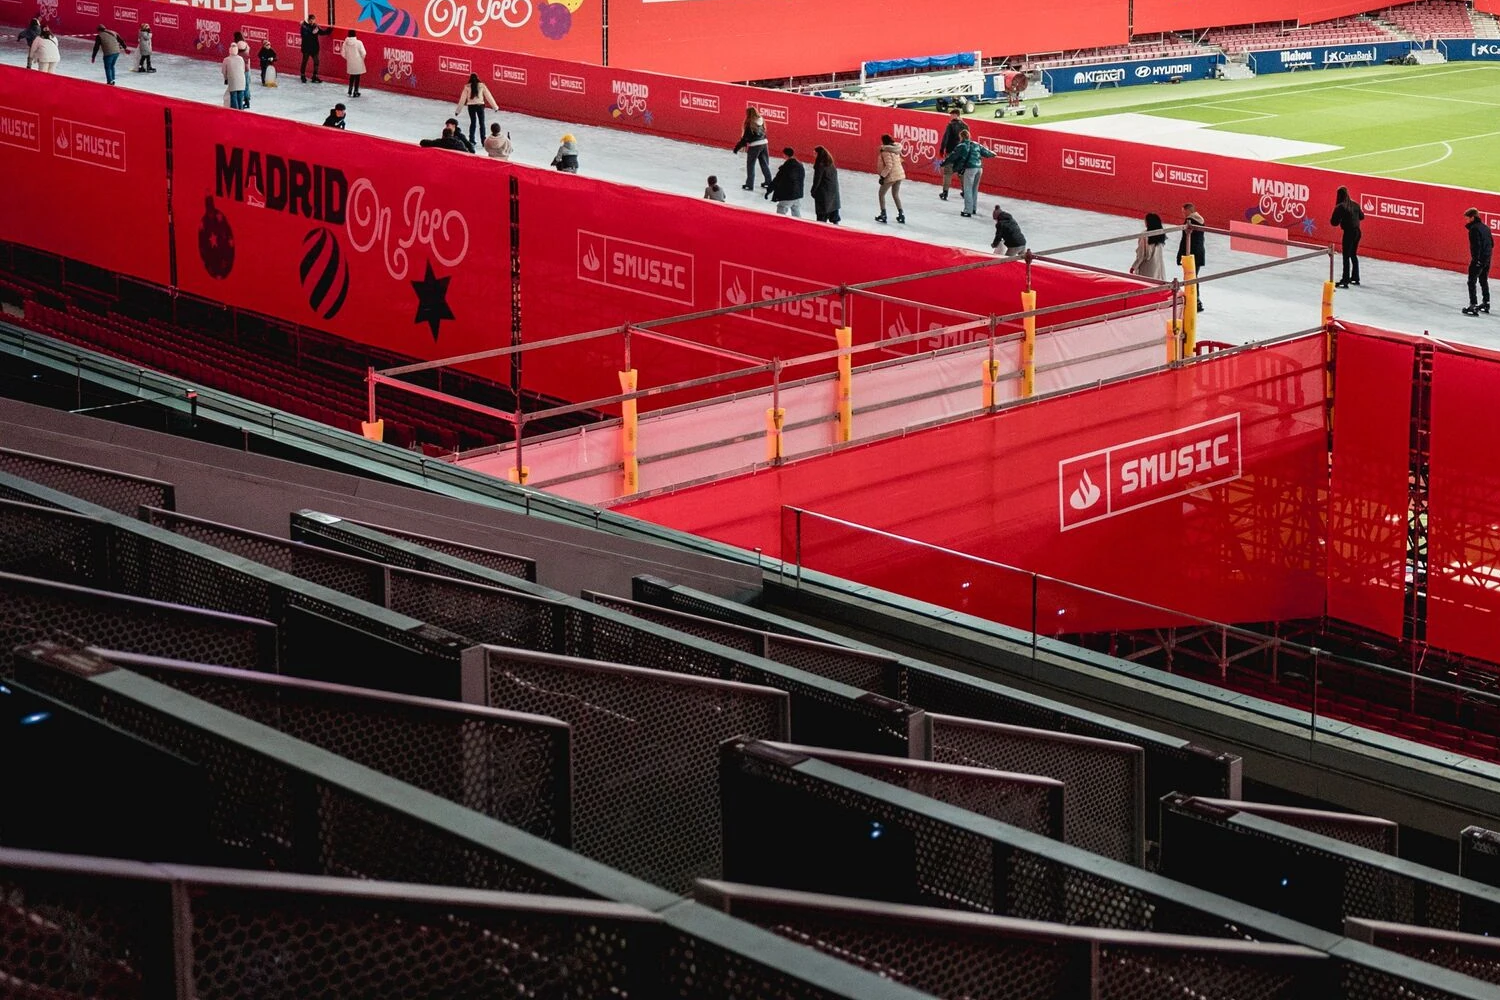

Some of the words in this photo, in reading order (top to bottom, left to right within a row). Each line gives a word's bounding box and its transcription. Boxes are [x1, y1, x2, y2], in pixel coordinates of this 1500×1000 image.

[196, 18, 220, 32] MADRID
[248, 30, 268, 40] SMUSIC
[384, 47, 414, 63] MADRID
[1280, 51, 1312, 63] Mahou
[1338, 49, 1373, 62] CaixaBank
[449, 61, 470, 73] SMUSIC
[1152, 64, 1192, 76] HYUNDAI
[503, 70, 525, 81] SMUSIC
[561, 79, 584, 91] SMUSIC
[612, 80, 649, 99] MADRID
[692, 97, 717, 109] SMUSIC
[759, 107, 785, 120] SMUSIC
[831, 118, 859, 132] SMUSIC
[893, 123, 938, 145] MADRID
[76, 133, 120, 159] SMUSIC
[993, 143, 1024, 156] SMUSIC
[1078, 156, 1112, 170] SMUSIC
[1169, 170, 1204, 185] SMUSIC
[1252, 177, 1310, 203] MADRID
[215, 143, 348, 226] MADRID
[346, 177, 408, 281] On
[402, 184, 469, 267] Ice
[1259, 193, 1284, 223] On
[1278, 195, 1306, 220] Ice
[1380, 202, 1420, 219] SMUSIC
[613, 252, 686, 289] SMUSIC
[761, 285, 846, 326] SMUSIC
[1121, 433, 1229, 495] SMUSIC
